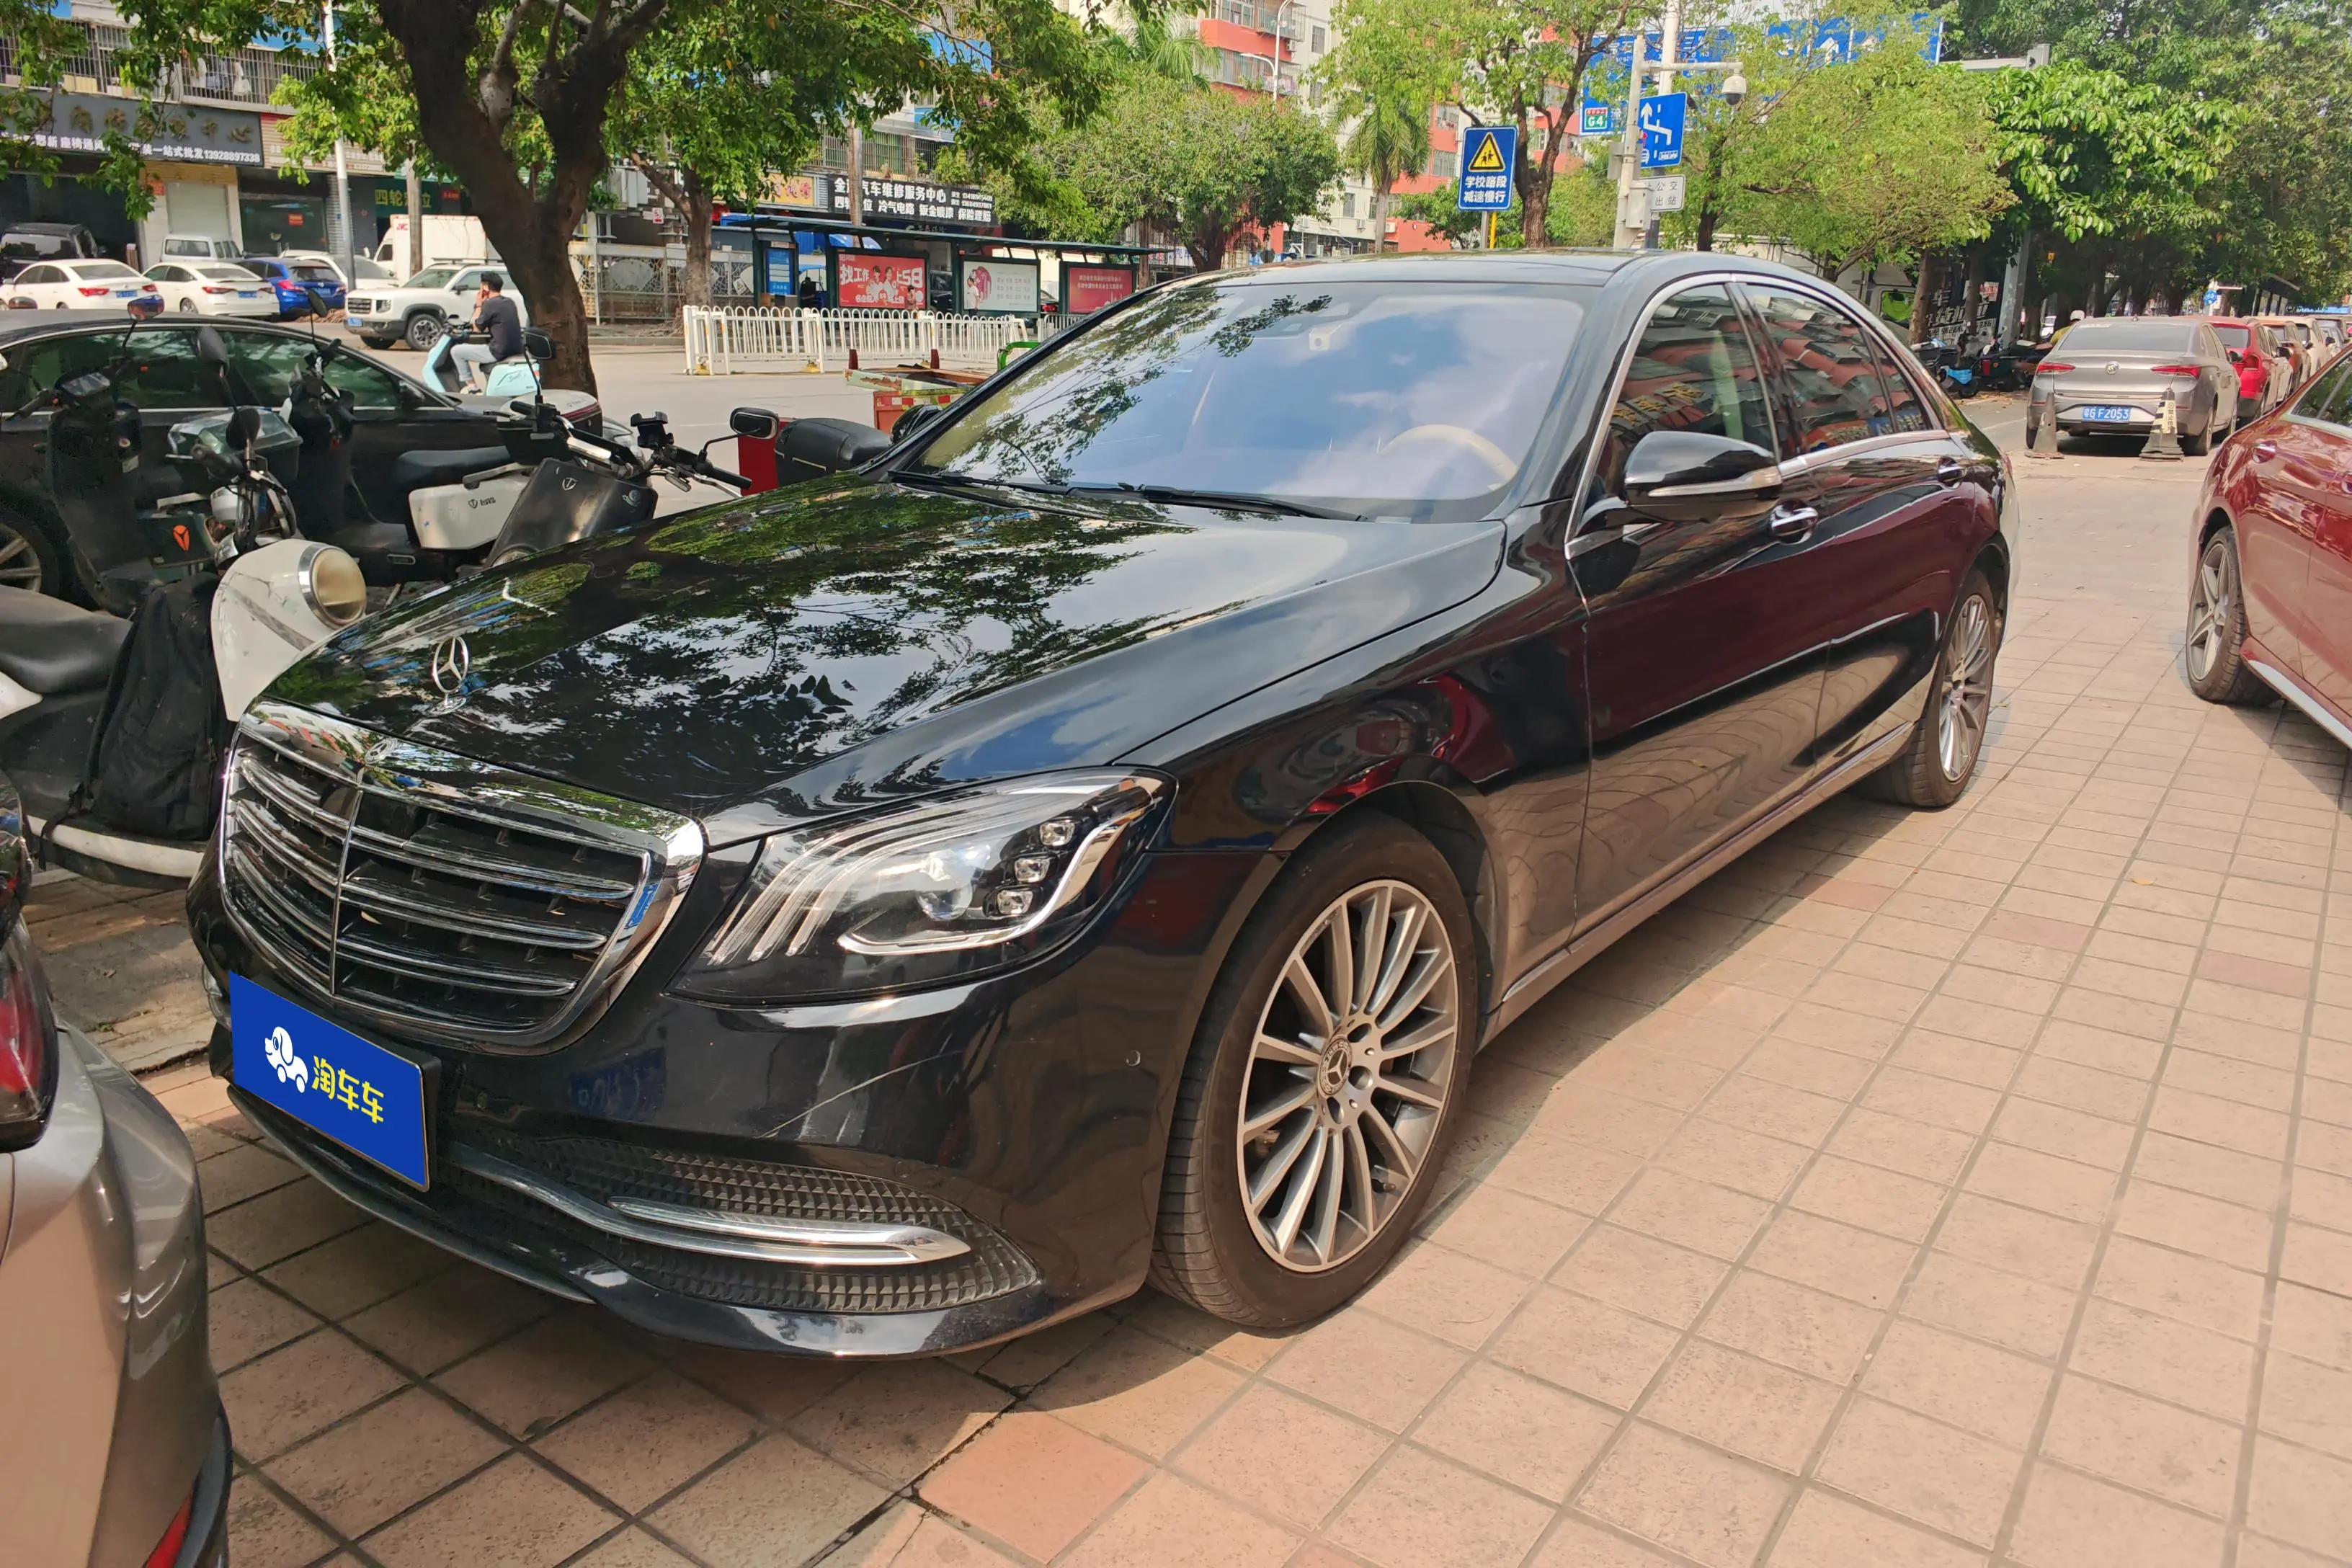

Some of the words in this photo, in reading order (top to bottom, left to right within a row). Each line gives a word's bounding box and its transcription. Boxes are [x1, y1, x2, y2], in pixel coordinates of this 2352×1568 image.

[1588, 115, 1604, 127] G4
[1465, 175, 1507, 188] 学校路段
[834, 177, 946, 203] 金汽车维修服务中心
[1464, 190, 1506, 202] 减速慢行
[834, 196, 873, 212] 四轮位
[878, 200, 915, 215] 冷气电路
[919, 203, 954, 219] 钣金喷漆
[958, 208, 992, 223] 保险理赔
